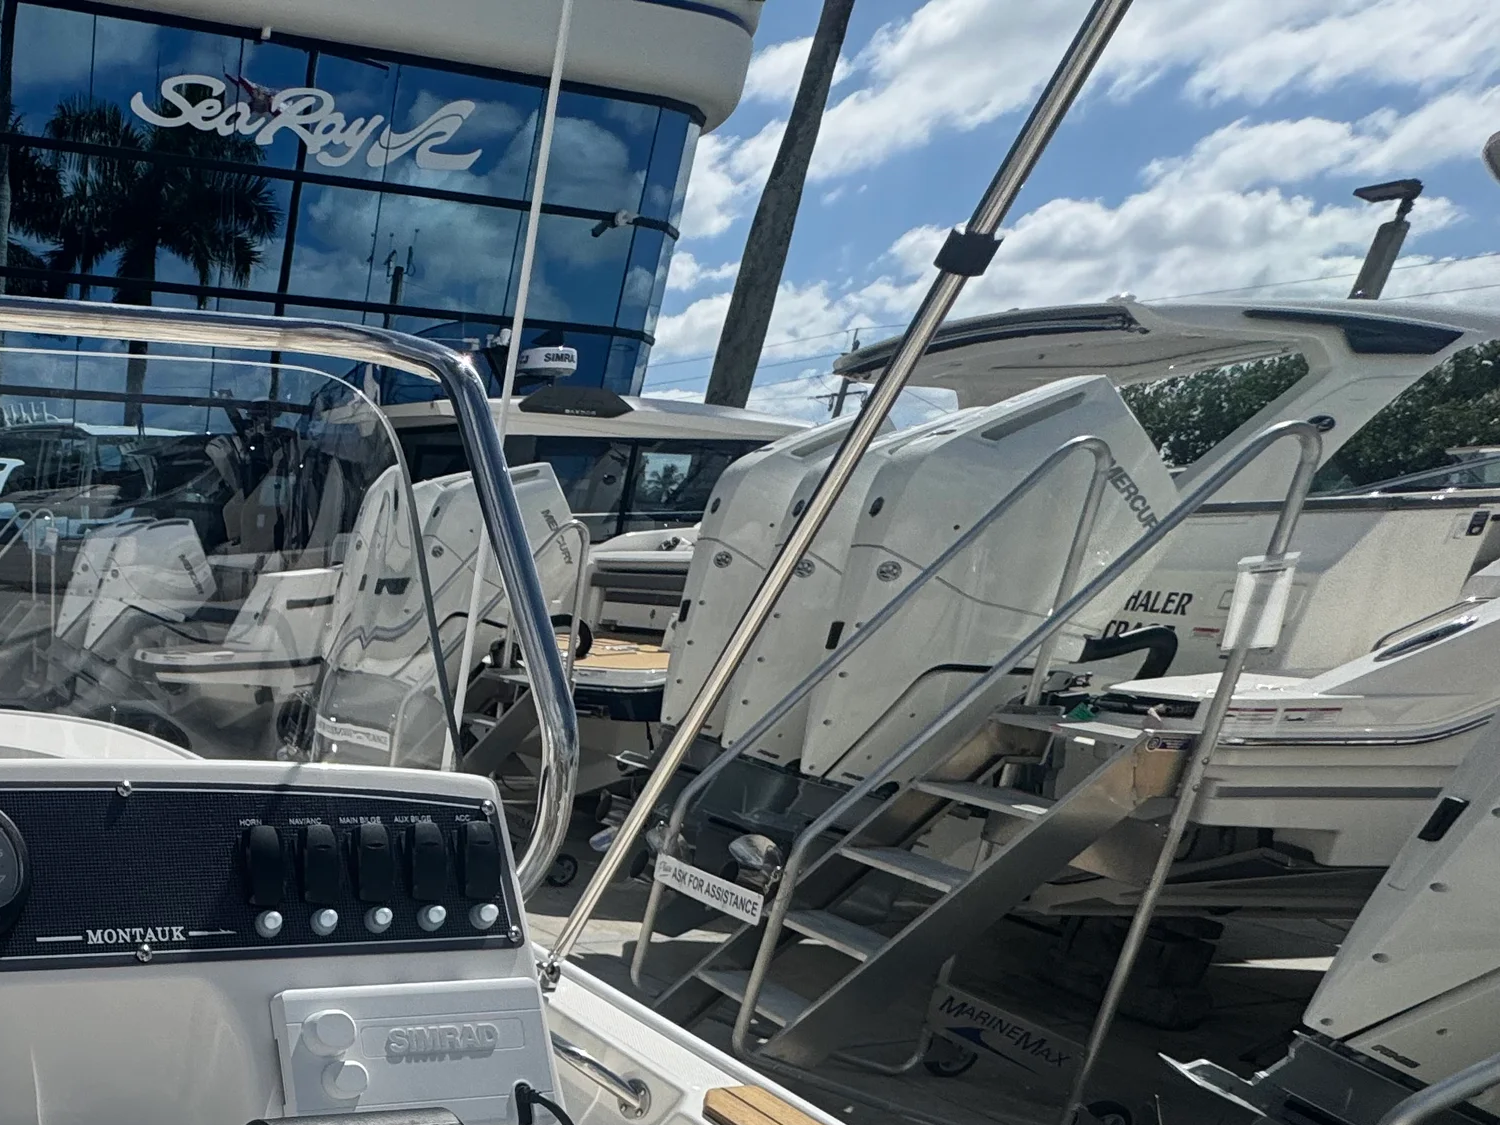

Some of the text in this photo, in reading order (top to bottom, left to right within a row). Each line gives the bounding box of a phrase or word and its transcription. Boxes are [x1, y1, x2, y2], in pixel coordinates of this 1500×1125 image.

[131, 74, 385, 168] Sea Ray
[544, 352, 576, 363] SIMRA
[1107, 465, 1161, 529] MERCUR
[541, 509, 574, 565] MECURY
[1123, 589, 1193, 616] HALER
[239, 818, 263, 826] HORN
[339, 816, 383, 824] MAIN BILGE
[393, 814, 433, 823] AUX BILGE
[455, 814, 471, 822] ACC
[671, 867, 688, 887] ASK
[688, 873, 705, 894] FOR
[703, 881, 759, 917] ASSISTANCE
[86, 926, 186, 945] MONTAUK
[387, 1022, 499, 1054] SIMRAD
